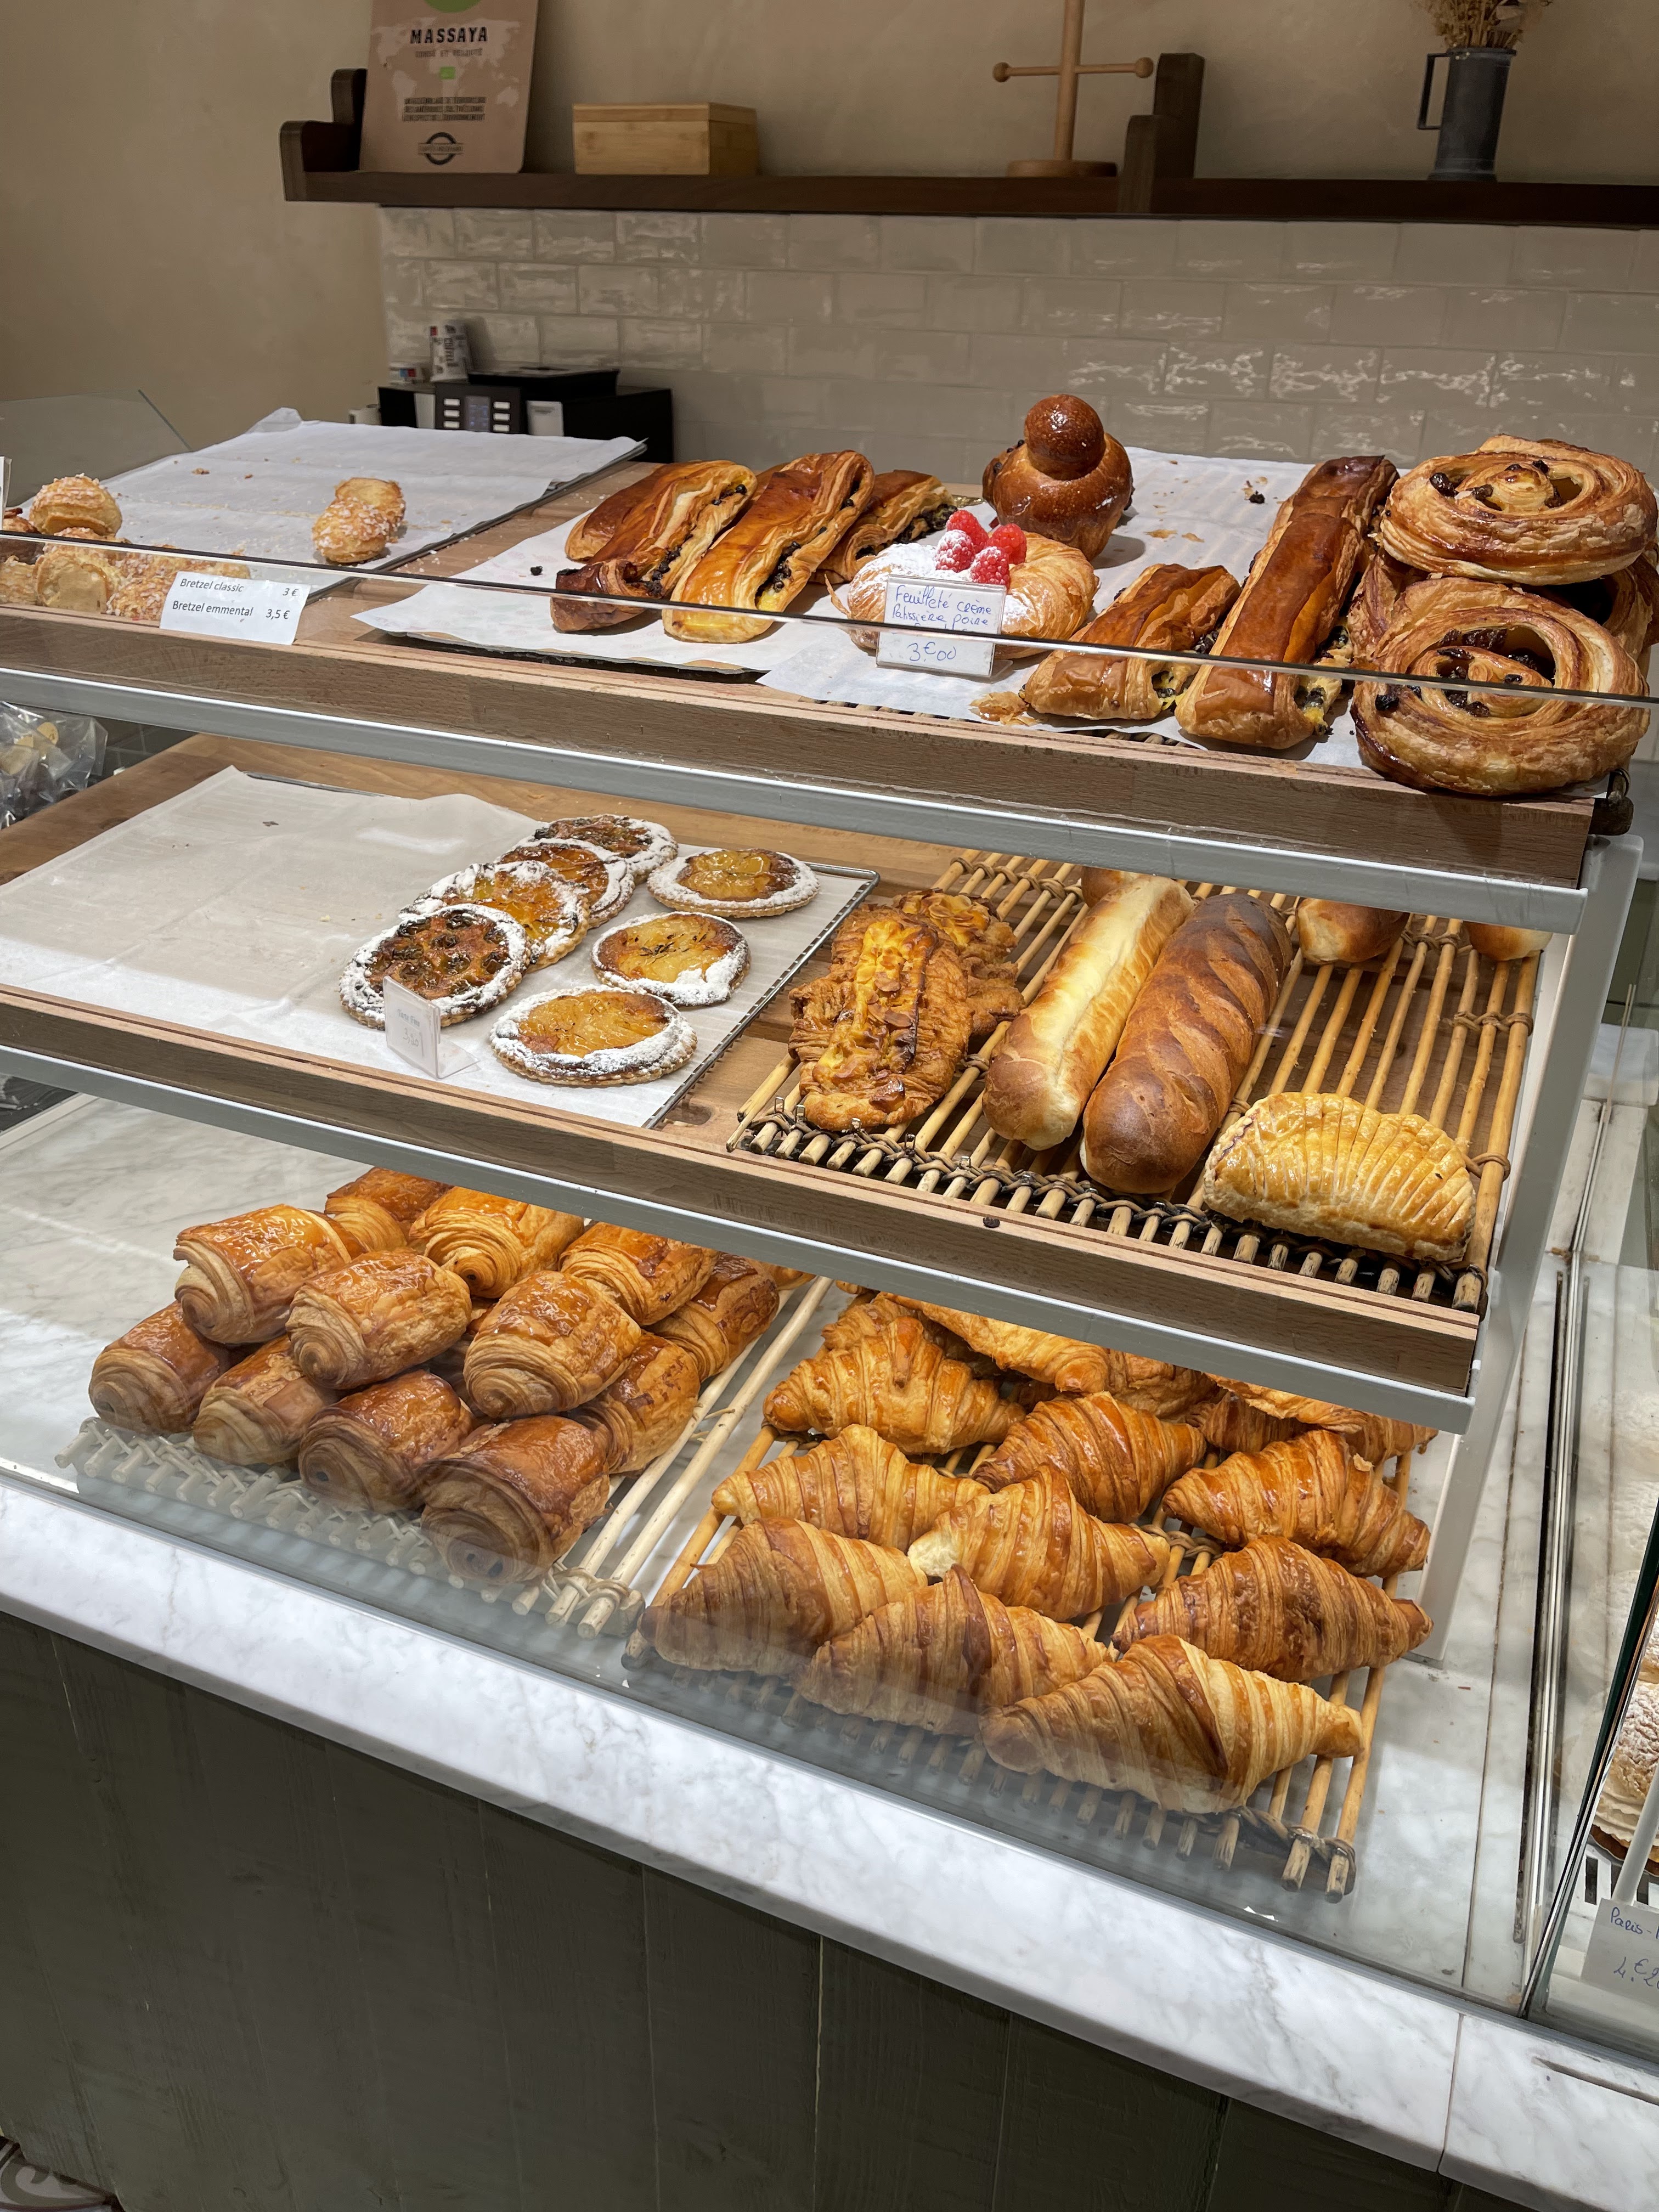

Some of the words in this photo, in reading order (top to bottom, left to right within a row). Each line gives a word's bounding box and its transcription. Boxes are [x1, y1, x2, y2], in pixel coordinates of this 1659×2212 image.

[410, 26, 488, 44] MASSAYA
[180, 578, 213, 590] Bretzel
[214, 583, 244, 592] classic
[283, 588, 290, 596] 3
[291, 588, 298, 596] €
[172, 600, 205, 612] Bretzel
[206, 605, 253, 616] emmental
[266, 608, 281, 620] 3,5
[283, 610, 290, 619] €
